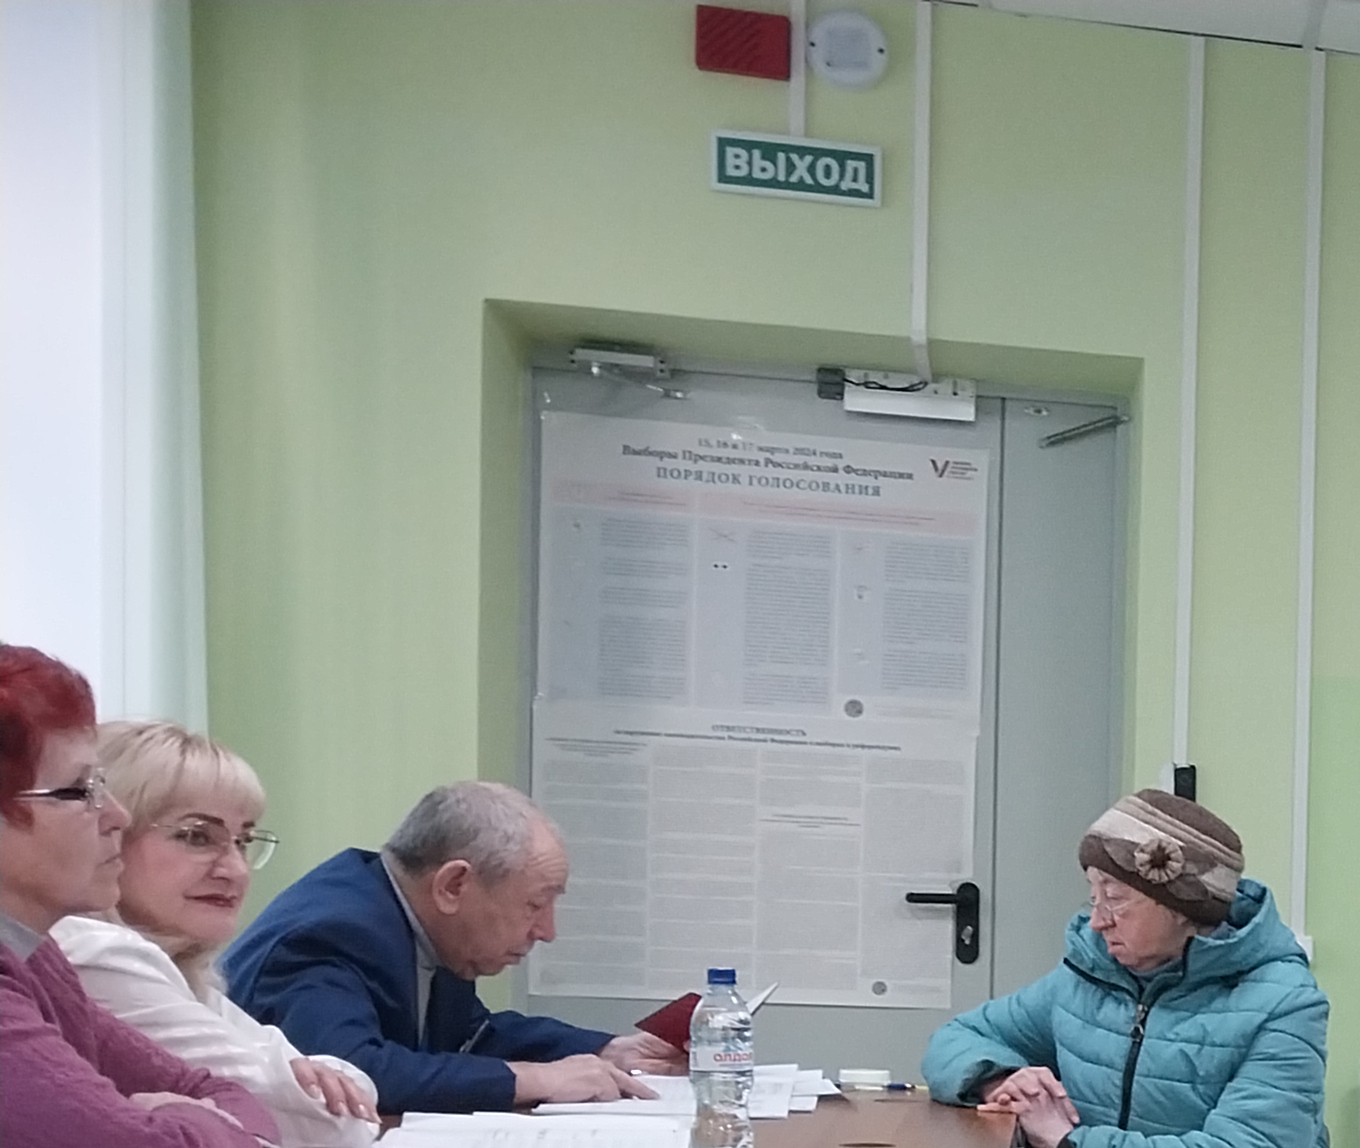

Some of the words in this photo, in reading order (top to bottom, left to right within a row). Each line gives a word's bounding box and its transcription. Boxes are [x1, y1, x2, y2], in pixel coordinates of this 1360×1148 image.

[725, 146, 869, 193] ВЫХОД
[656, 466, 742, 486] ПОРЯДОК
[748, 475, 882, 497] ГОЛОСОВАНИЯ
